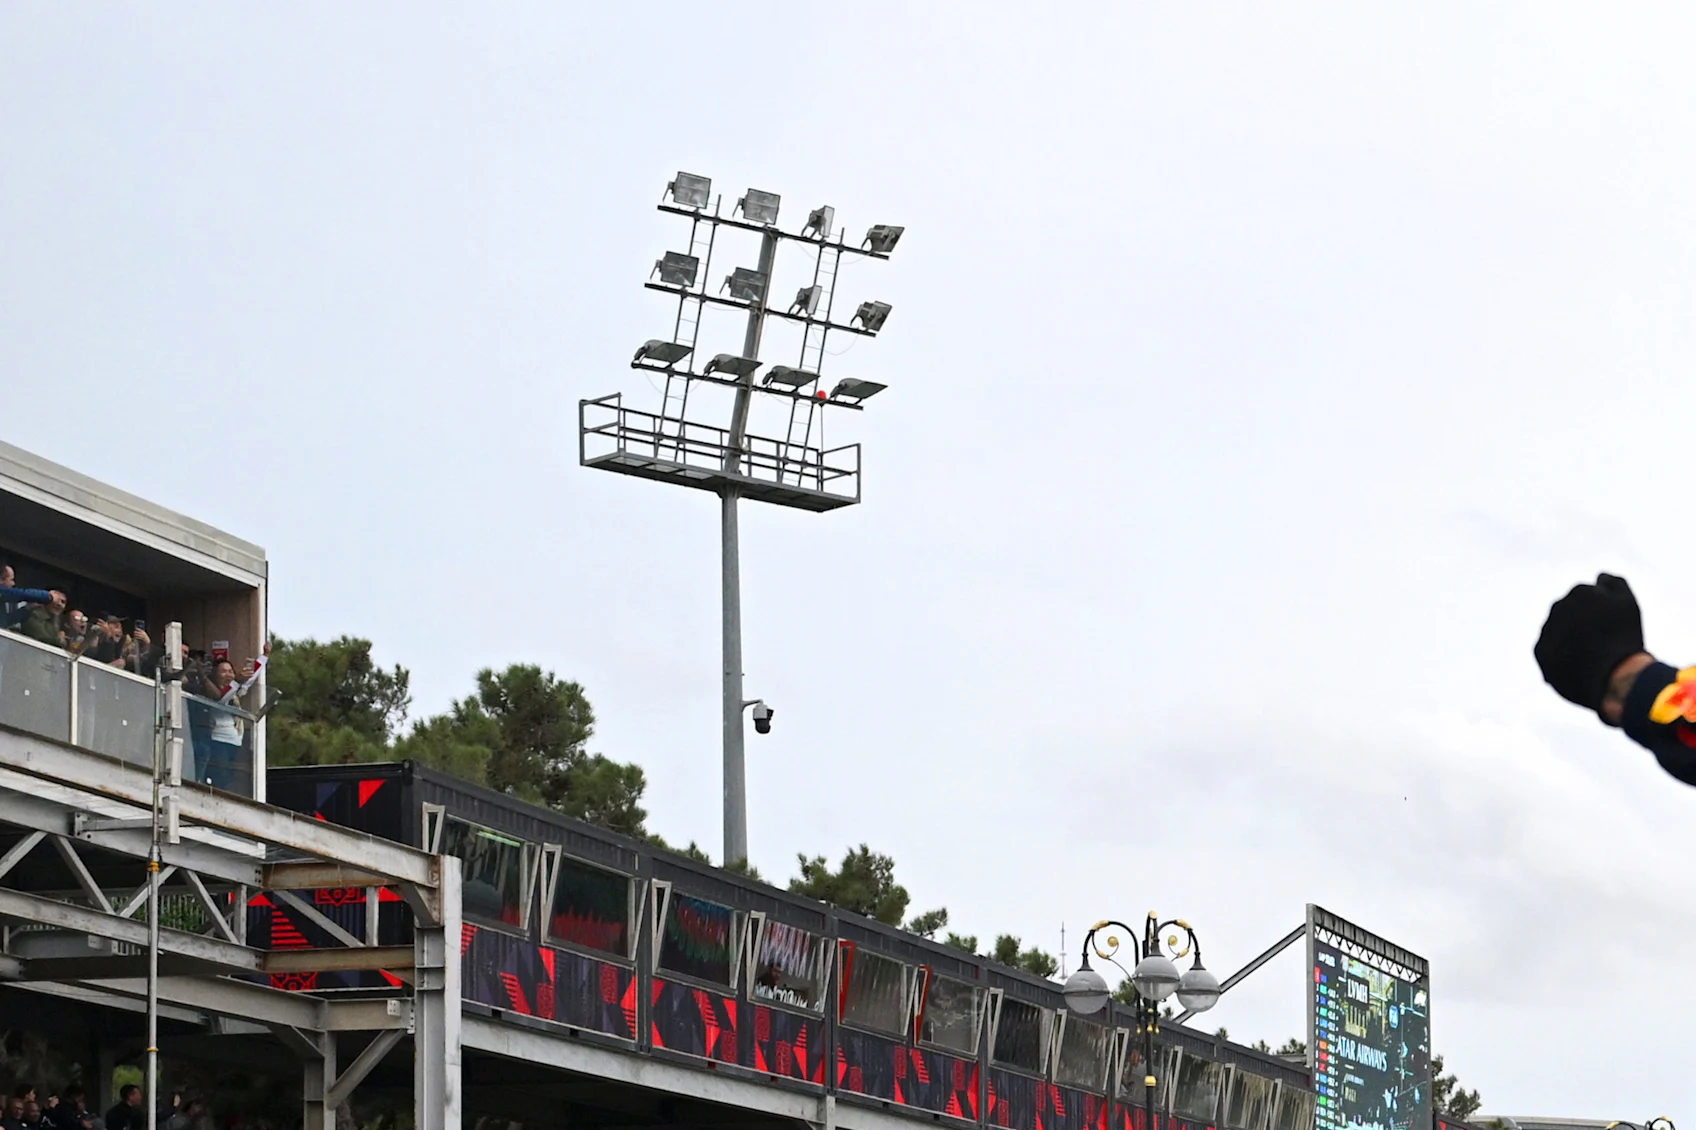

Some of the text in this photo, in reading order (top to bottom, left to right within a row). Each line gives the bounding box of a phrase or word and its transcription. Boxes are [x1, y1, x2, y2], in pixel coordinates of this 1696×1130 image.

[1348, 978, 1368, 1004] LVMH
[1336, 1035, 1388, 1072] ATAR AIRWAYS
